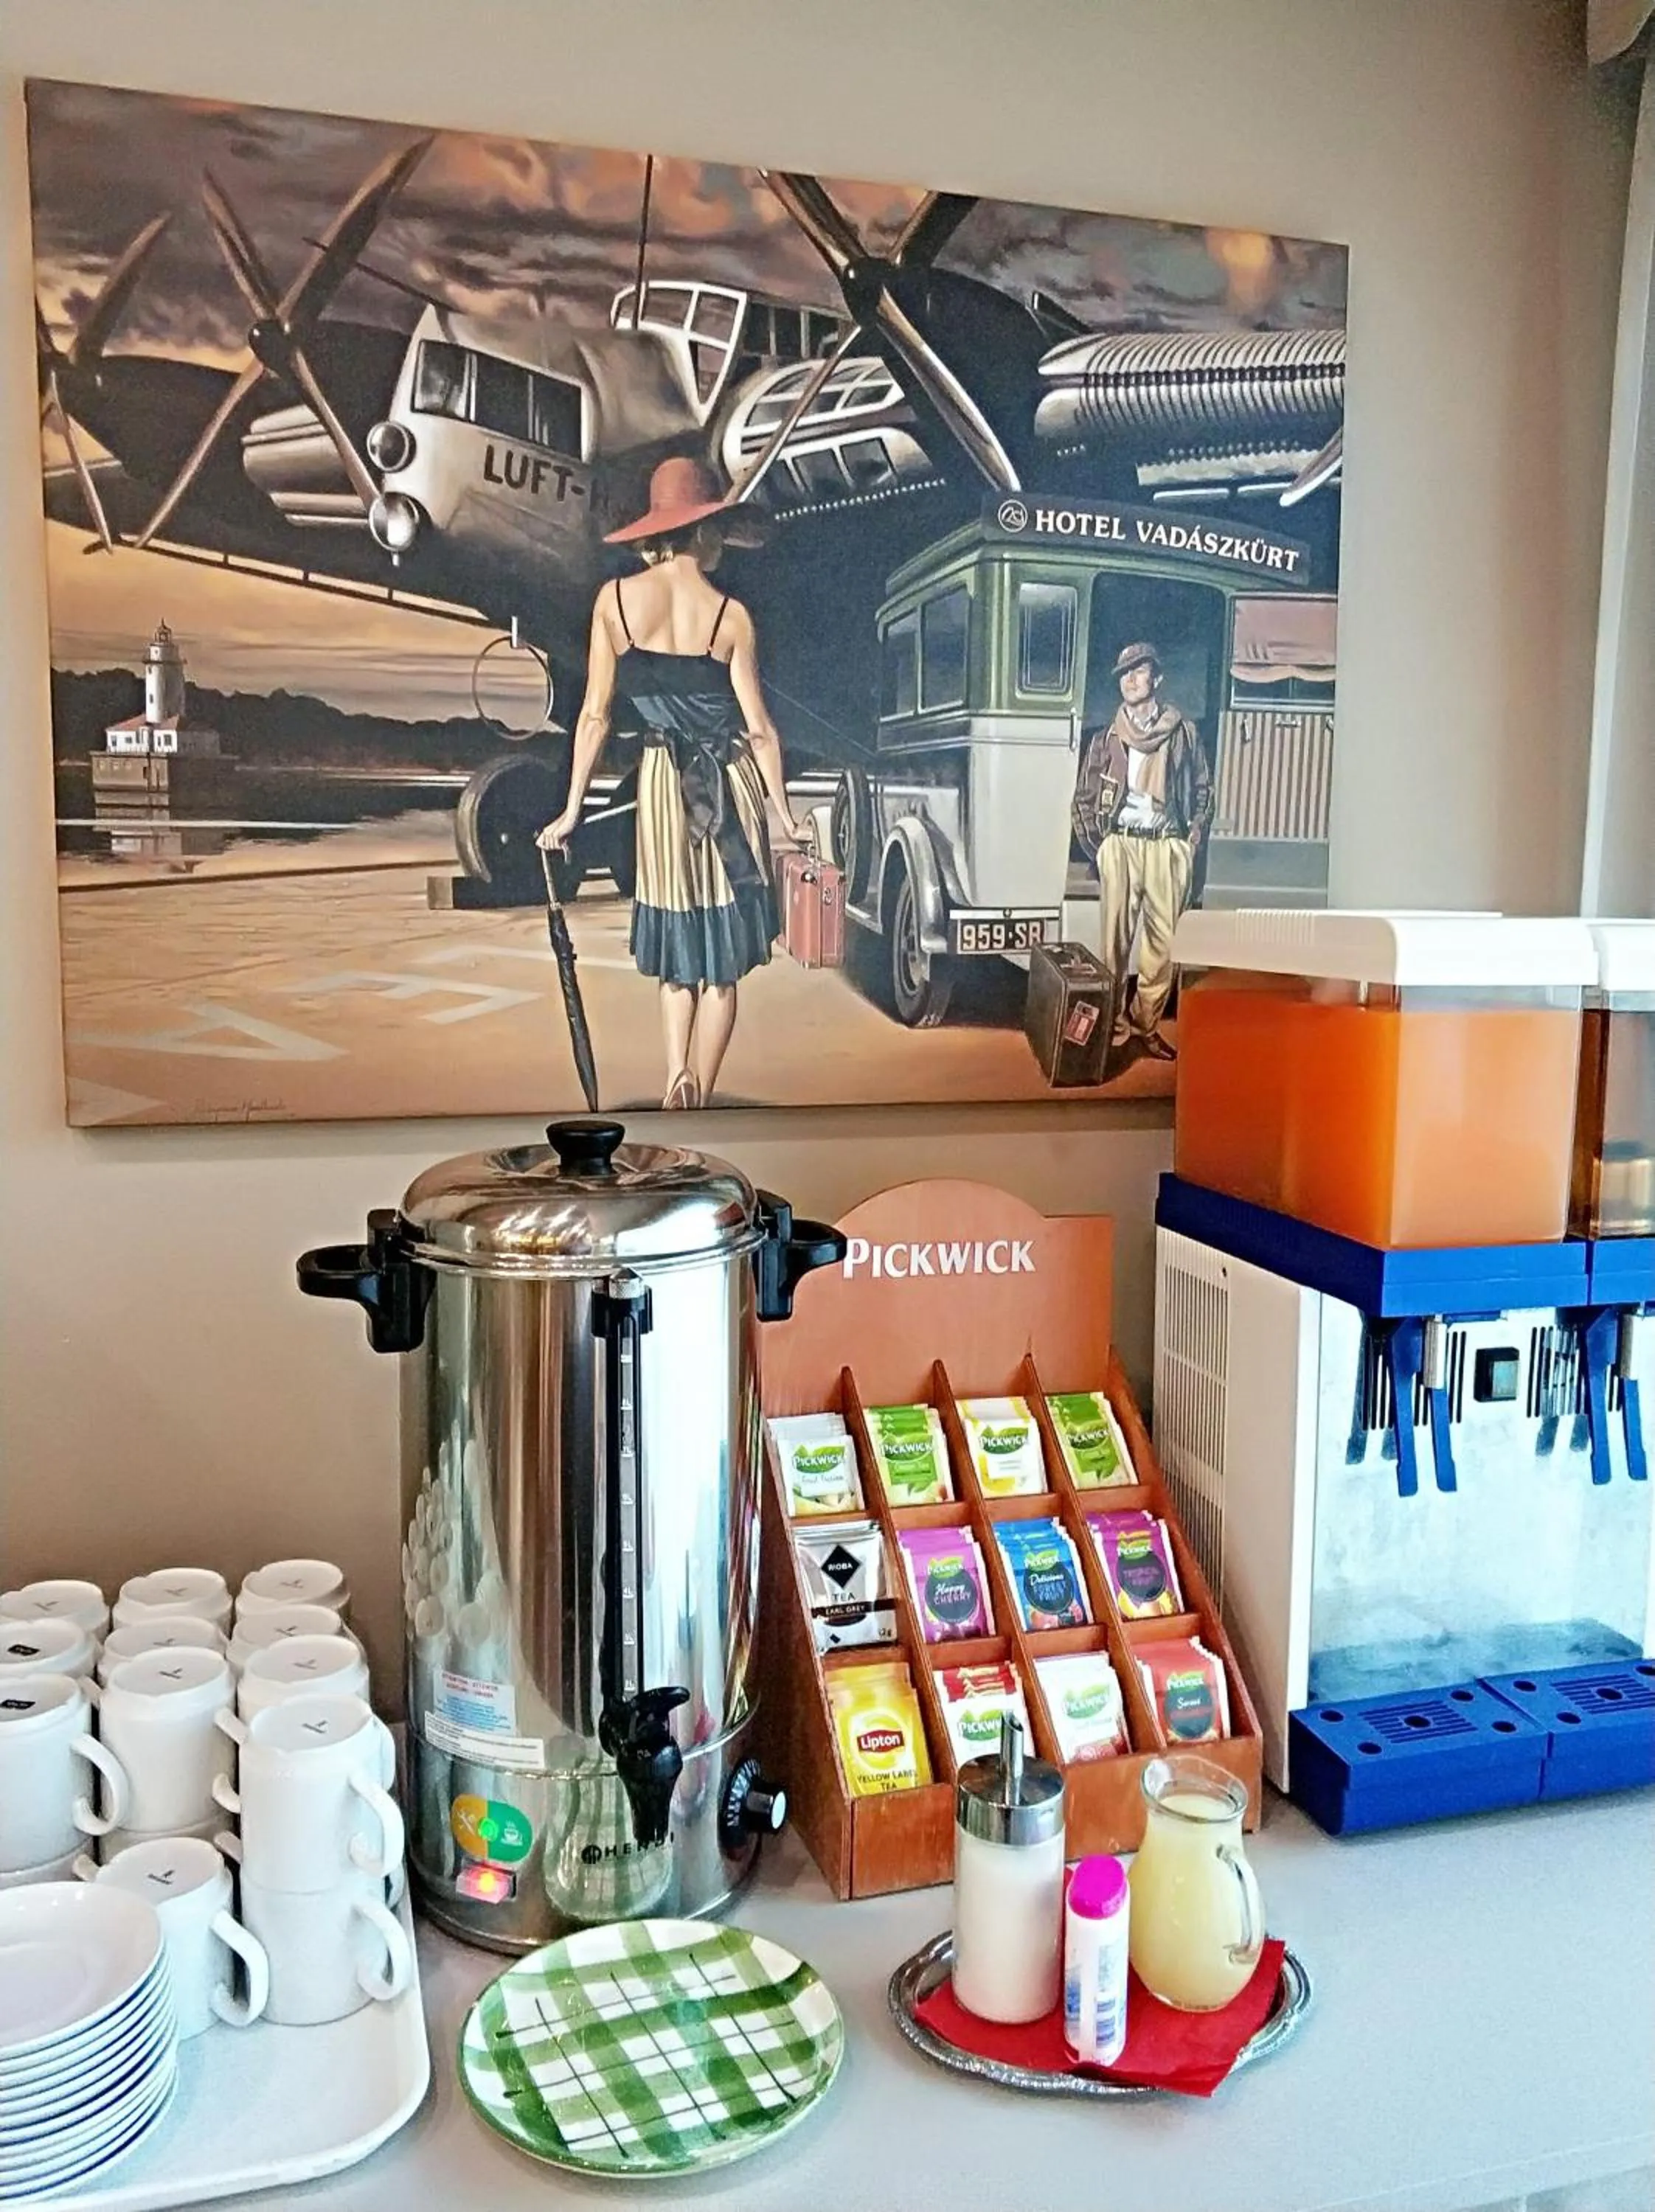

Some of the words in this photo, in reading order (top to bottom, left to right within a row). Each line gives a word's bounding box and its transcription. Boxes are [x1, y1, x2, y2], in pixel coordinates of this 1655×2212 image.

[1035, 509, 1125, 540] HOTEL
[1137, 521, 1299, 572] VADÁSZKÜRT
[843, 1238, 1036, 1279] PICKWICK
[828, 1562, 853, 1571] RIOBA
[832, 1593, 856, 1602] TEA
[860, 1734, 901, 1753] Lipton
[857, 1773, 890, 1784] YELLOW
[880, 1781, 898, 1790] TEA
